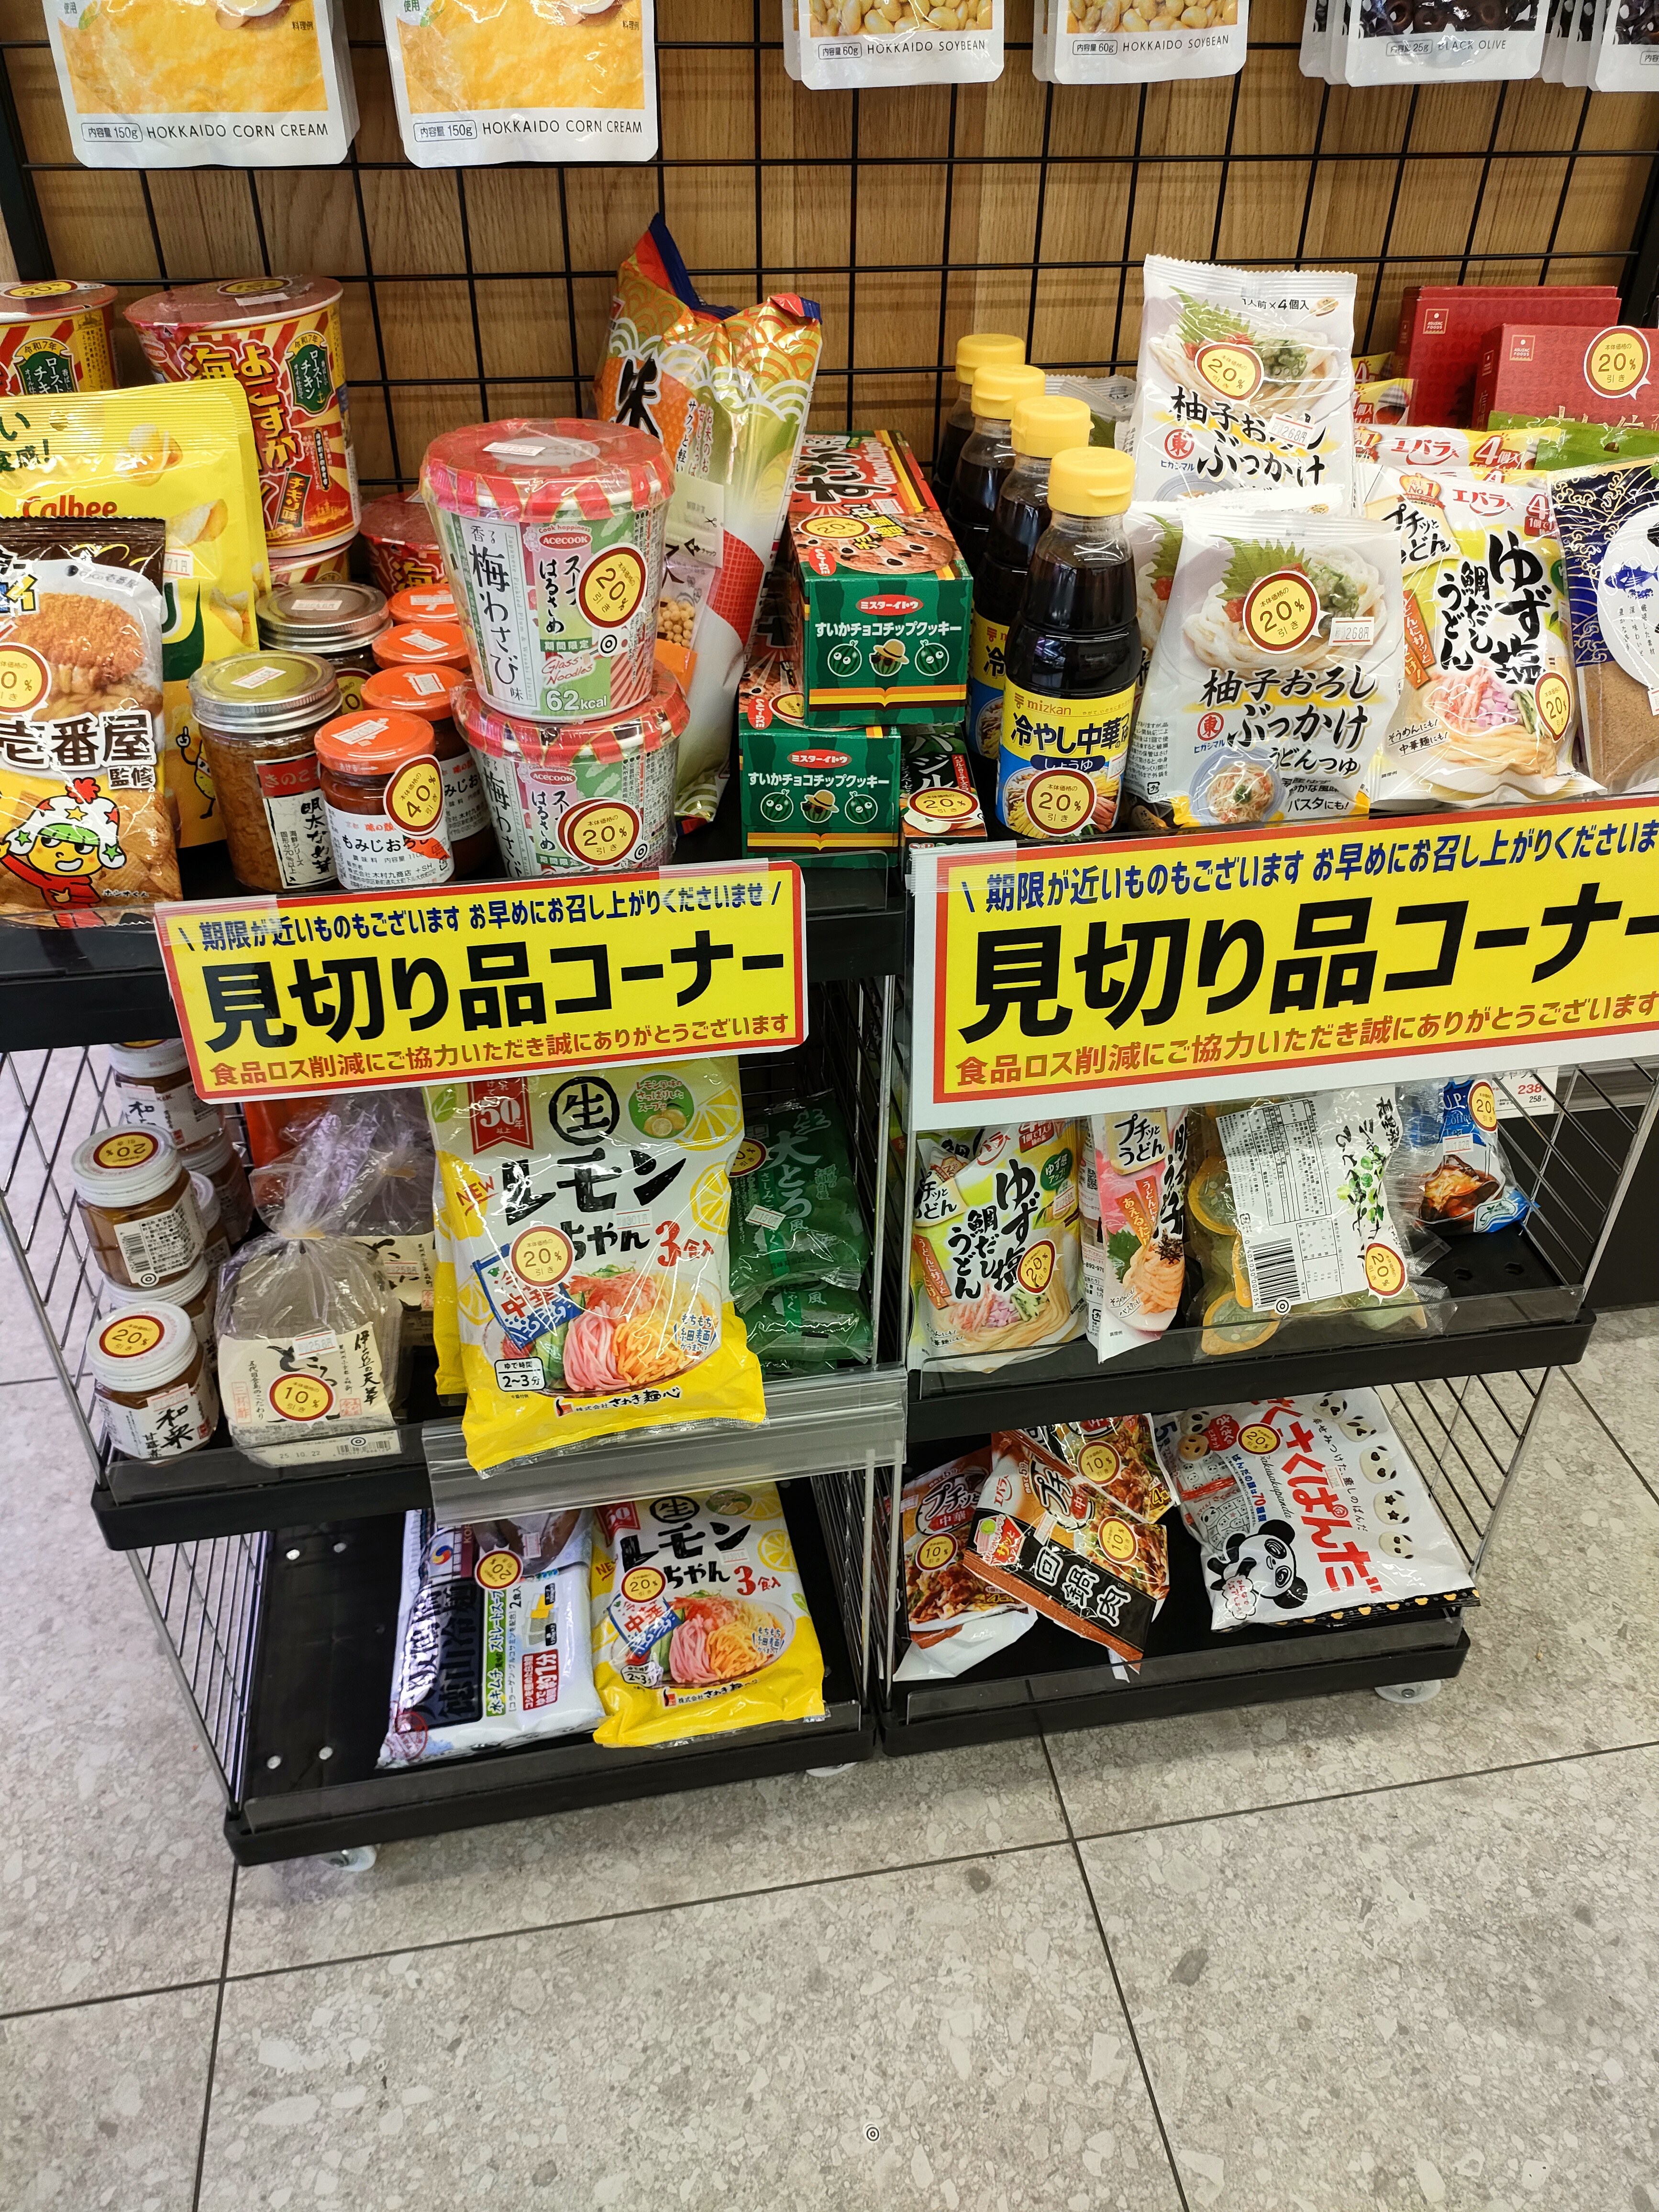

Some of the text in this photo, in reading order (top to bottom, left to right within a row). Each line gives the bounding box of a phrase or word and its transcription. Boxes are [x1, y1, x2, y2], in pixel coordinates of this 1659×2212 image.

[822, 40, 986, 57] 内容量 HOKKAIDO SOYBEAN
[1076, 35, 1229, 53] 内容量 HOKKAIDO SOYBEAN
[1438, 40, 1506, 50] BLACK OLIVE
[88, 122, 329, 140] 内容量 150g HOKKAIDO CORN CREAM
[420, 120, 642, 138] 内容量 150g HOKKAIDO CORN CREAM
[24, 341, 57, 355] 令和7年
[1598, 353, 1636, 372] 20%
[300, 360, 315, 399] チキン
[1208, 359, 1245, 389] 20%
[1607, 374, 1625, 383] 引き
[676, 400, 697, 473] サクッと軽い
[1169, 434, 1192, 457] 東
[1391, 437, 1459, 457] エバラ
[1197, 430, 1325, 487] ぶっかけ
[1452, 489, 1514, 510] エバラ
[540, 558, 564, 634] はるさめ
[595, 568, 629, 611] 20%
[1260, 587, 1289, 608] 本体価格の
[469, 544, 519, 685] 梅わさび
[860, 601, 918, 610] ミスターイトウ
[1260, 599, 1304, 633] 20%
[1460, 562, 1493, 653] 鯛だし
[1489, 531, 1551, 685] ゆず塩
[816, 622, 962, 638] すいかチョコチップクッキー
[1278, 621, 1298, 637] 引き
[1438, 574, 1474, 671] うどん
[544, 641, 589, 650] 期間限定
[542, 657, 578, 674] Glass
[546, 664, 593, 685] Noodles
[510, 688, 523, 701] 味
[1202, 666, 1377, 706] 柚子おろし
[546, 690, 607, 711] 62kcal
[1027, 701, 1071, 716] mizkan
[1546, 700, 1568, 720] 20%
[1203, 719, 1218, 736] 東
[1227, 705, 1366, 749] ぶっかけ
[1388, 720, 1439, 741] そうめんにも!
[1, 716, 152, 763] 壱番屋
[1194, 740, 1225, 753] ヒガシマル
[1400, 732, 1448, 755] 中華麺にも!
[1267, 748, 1360, 774] うどんつゆ
[110, 768, 154, 787] 監修
[749, 773, 889, 788] すいかチョコチップクッキー
[407, 775, 436, 818] 40%
[923, 799, 965, 808] 20%
[1039, 792, 1081, 812] 20%
[1288, 797, 1349, 812] パスタにも!
[531, 791, 555, 851] はるさめ
[587, 815, 618, 826] 本体価格の
[1048, 813, 1068, 822] 引き
[582, 826, 627, 846] 20%
[596, 844, 618, 855] 引き
[985, 820, 1659, 914] 期限が近いものもございます お早めにお召し上がりくださいま
[199, 884, 763, 952] 期限が近いものもございます お早めにお召し上がりくださいませ
[959, 884, 1659, 1044] 見切り品コーナー
[205, 931, 785, 1052] 見切り品コーナー
[212, 1013, 788, 1086] 食品ロス削減にご協力いただき誠にありがとうございます
[956, 993, 1659, 1085] 食品ロス削減にご協力いただき誠にありがとうございます
[636, 1081, 682, 1090] レモン風味の
[637, 1090, 684, 1101] さっぱりした
[563, 1083, 611, 1133] 生
[1115, 1114, 1160, 1143] プチッと
[1045, 1154, 1068, 1173] ゆず感
[1118, 1142, 1165, 1166] うどん
[456, 1176, 495, 1206] NEW
[502, 1148, 686, 1225] レモン
[526, 1239, 553, 1248] 本体価格の
[561, 1221, 650, 1261] ちゃん
[655, 1221, 714, 1266] 3食入
[967, 1206, 997, 1276] 鯛だし
[524, 1248, 562, 1267] 20%
[918, 1238, 948, 1294] うどんにサッと
[948, 1227, 980, 1299] うどん
[536, 1266, 554, 1276] 引き
[1371, 1253, 1390, 1286] 20%
[682, 1315, 711, 1327] もちもち
[112, 1329, 150, 1346] 20%
[678, 1328, 711, 1345] 細麺
[354, 1330, 381, 1405] 伊豆の天草
[504, 1361, 532, 1370] ゆで時間
[285, 1386, 320, 1408] 10%
[576, 1403, 608, 1412] 株式会社
[1216, 1416, 1234, 1444] さくさくの
[1246, 1431, 1269, 1449] 20%
[1086, 1457, 1111, 1471] 10%
[994, 1475, 1009, 1507] エバラ
[660, 1500, 688, 1519] 生
[939, 1512, 966, 1526] 中華
[620, 1523, 751, 1572] レモン
[1111, 1527, 1124, 1551] 10%
[926, 1547, 949, 1558] 10%
[664, 1562, 730, 1588] ちゃん
[734, 1566, 781, 1595] 3食入
[630, 1580, 658, 1592] 20%
[1036, 1547, 1131, 1626] 回鍋肉
[758, 1627, 780, 1637] もちもち
[678, 1694, 703, 1703] 株式会社
